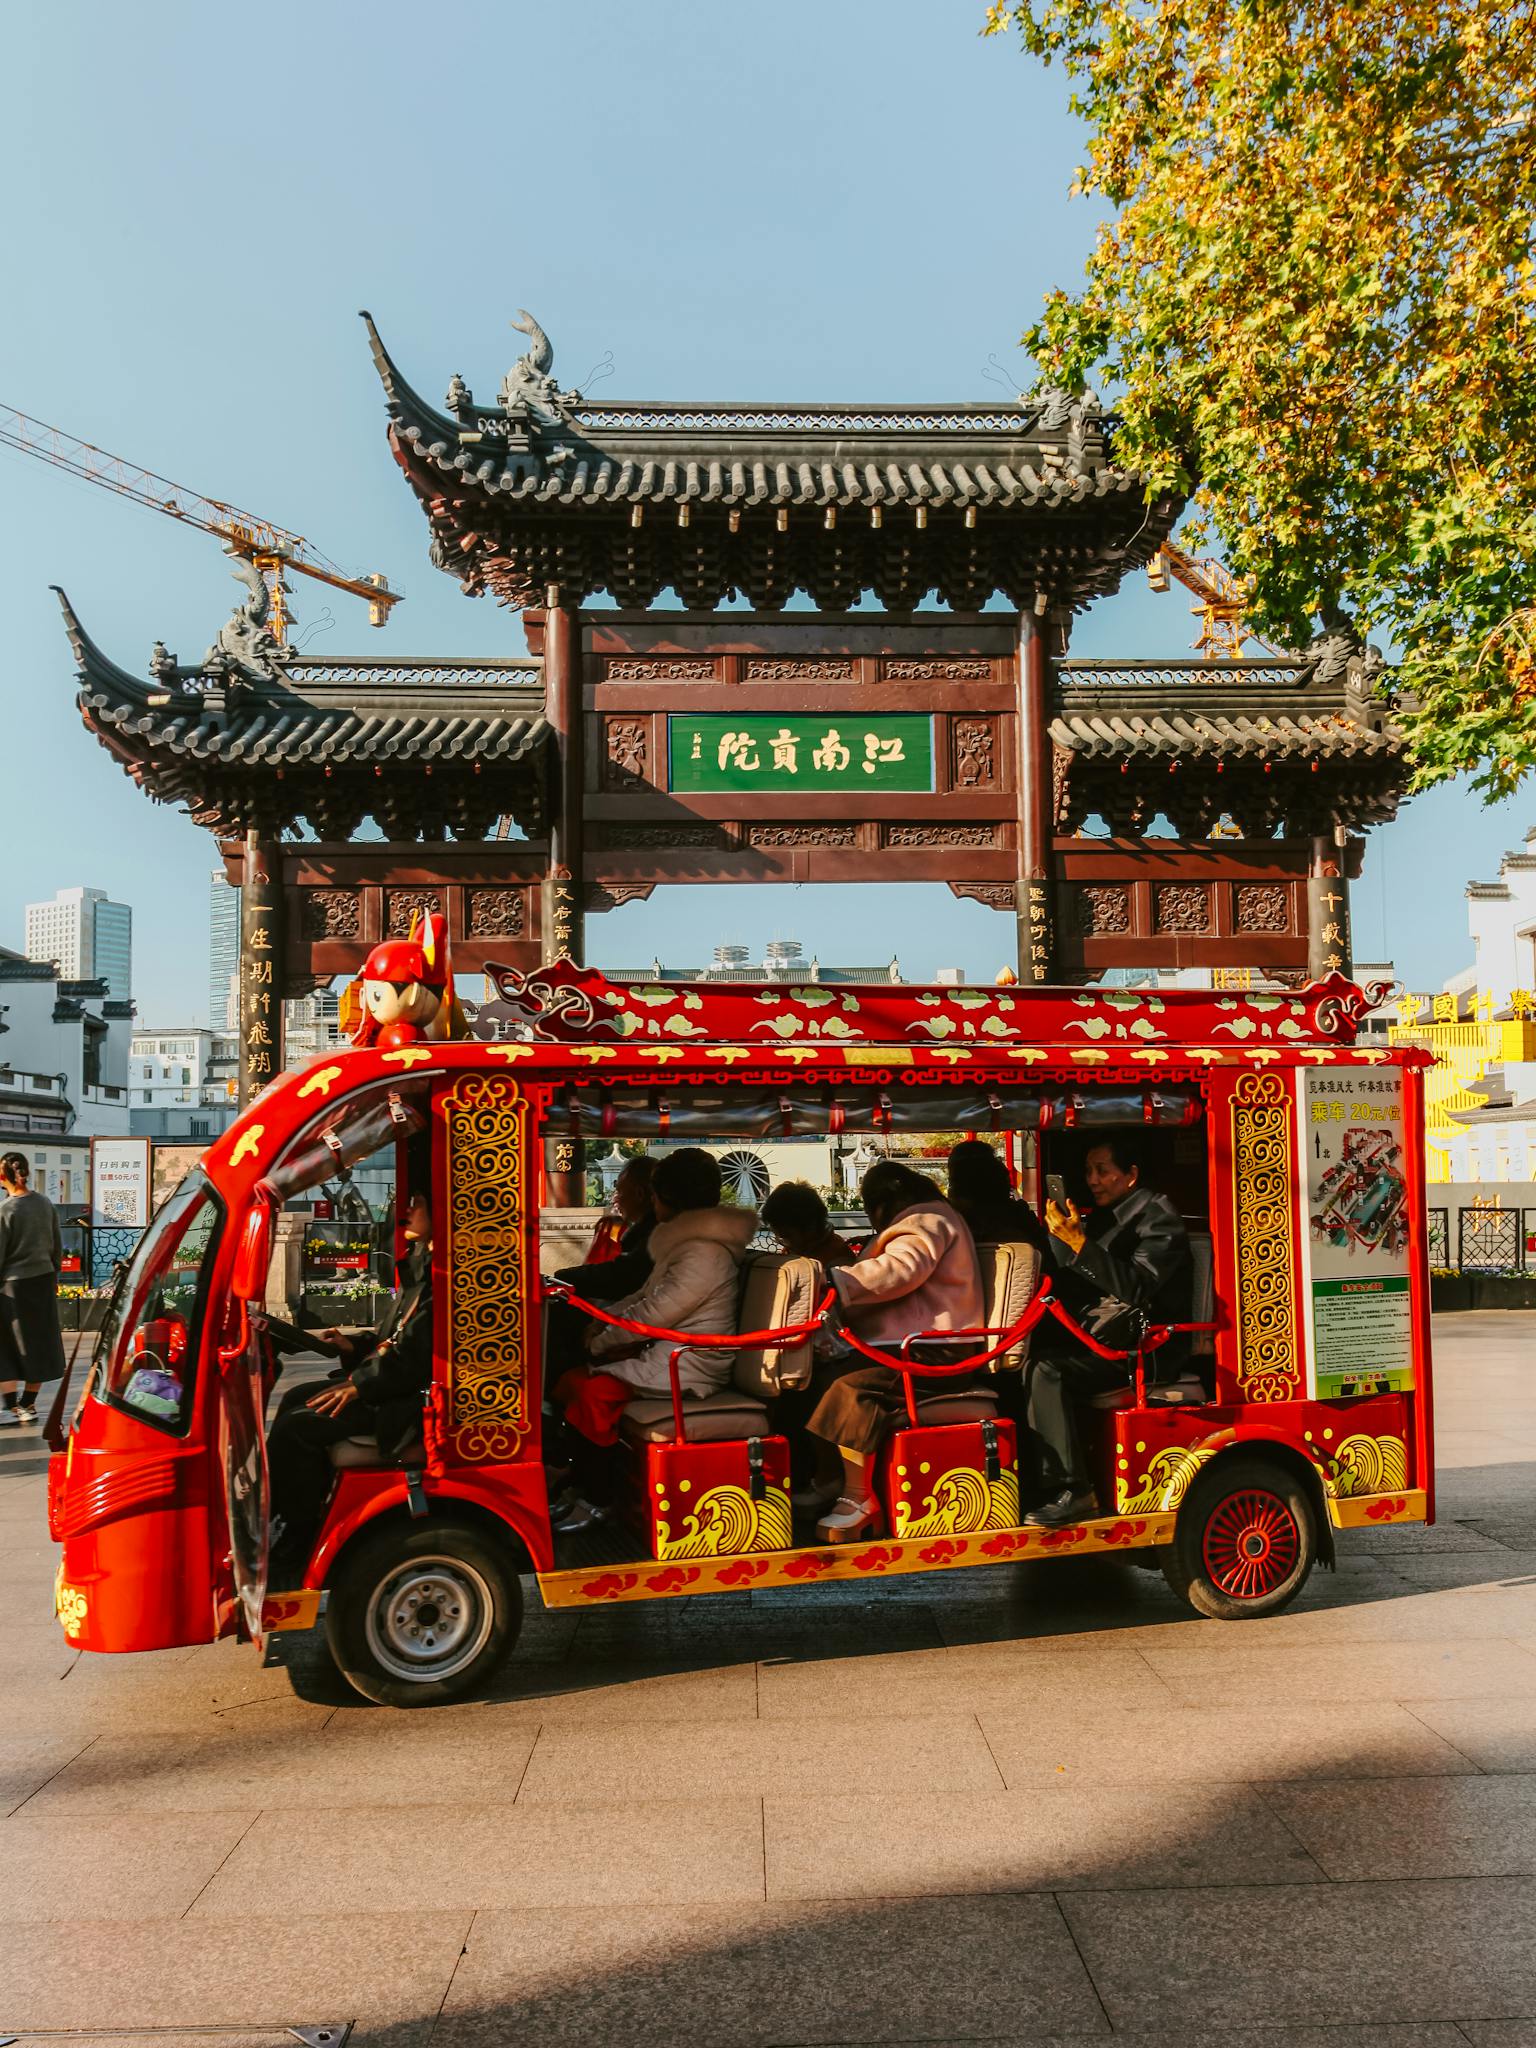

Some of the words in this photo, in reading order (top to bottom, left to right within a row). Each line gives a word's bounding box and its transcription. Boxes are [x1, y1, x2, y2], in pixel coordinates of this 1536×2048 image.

[718, 729, 906, 774] 江南貢院
[1311, 1101, 1345, 1123] 乘车
[1350, 1103, 1401, 1121] 20元/位
